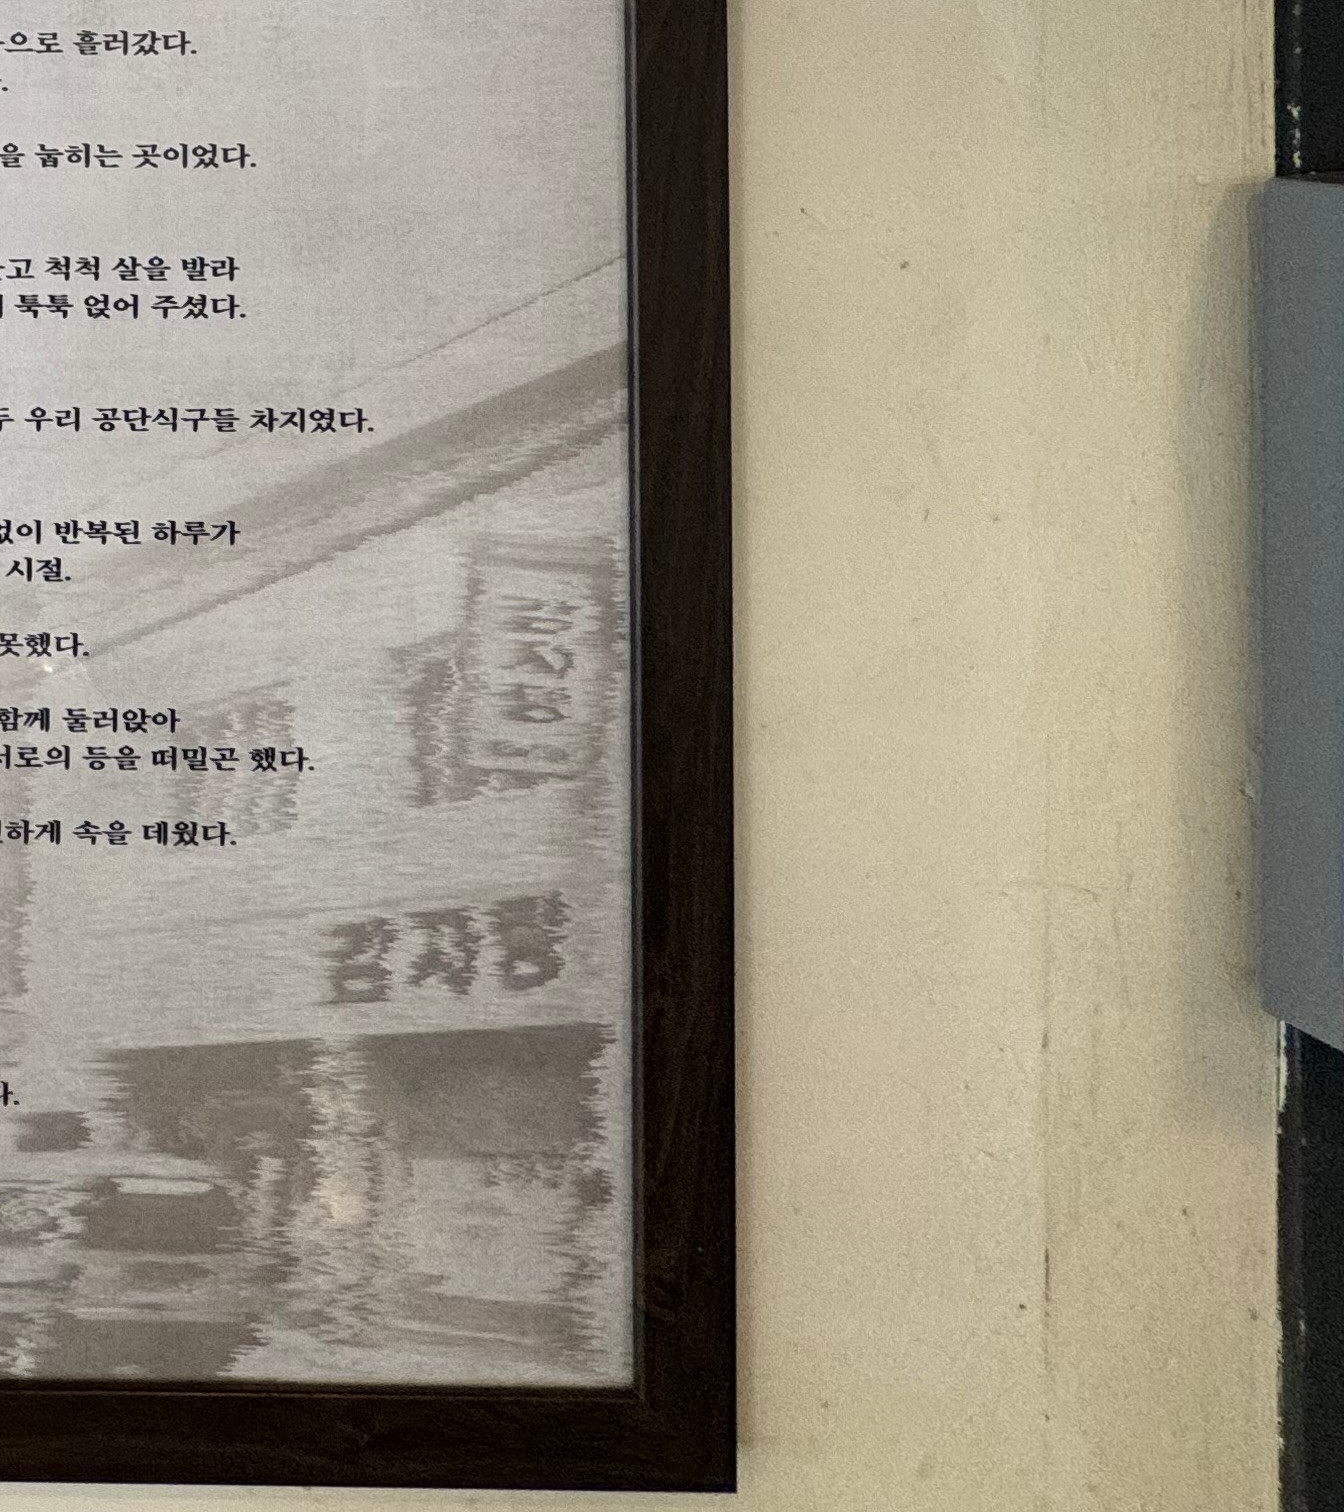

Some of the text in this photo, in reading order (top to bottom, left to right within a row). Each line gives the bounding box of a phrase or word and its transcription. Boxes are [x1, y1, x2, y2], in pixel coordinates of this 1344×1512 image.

[72, 29, 197, 56] 흘러갔다.
[34, 141, 124, 169] 눕히는
[131, 142, 257, 169] 곳이었다.
